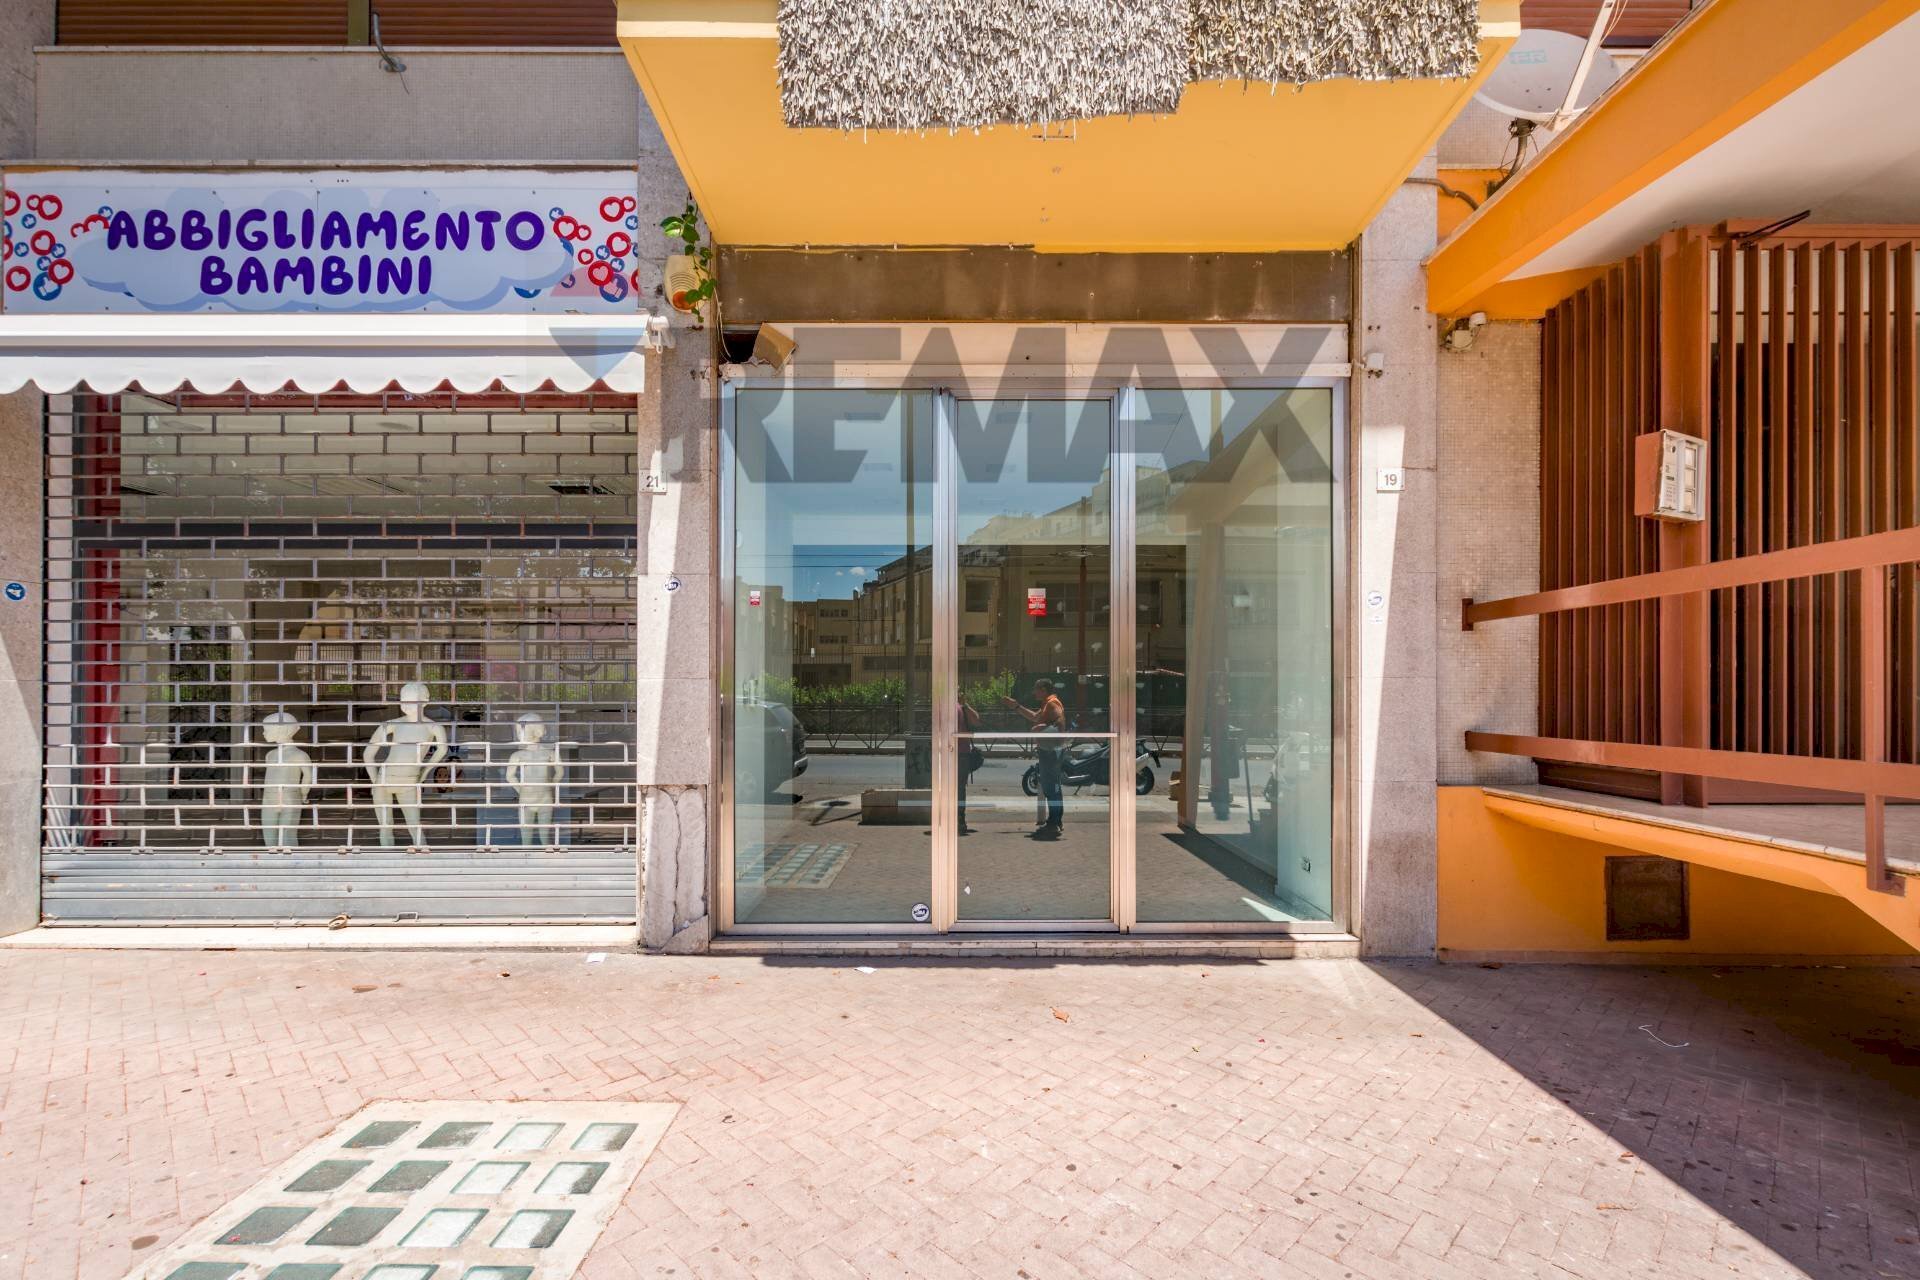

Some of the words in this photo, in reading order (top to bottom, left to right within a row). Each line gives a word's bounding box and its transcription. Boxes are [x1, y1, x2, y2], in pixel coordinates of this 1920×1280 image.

[107, 208, 544, 251] ABBIGLIAMENTO
[200, 254, 431, 295] BAMBINI
[646, 475, 659, 488] 21
[1383, 473, 1398, 486] 19
